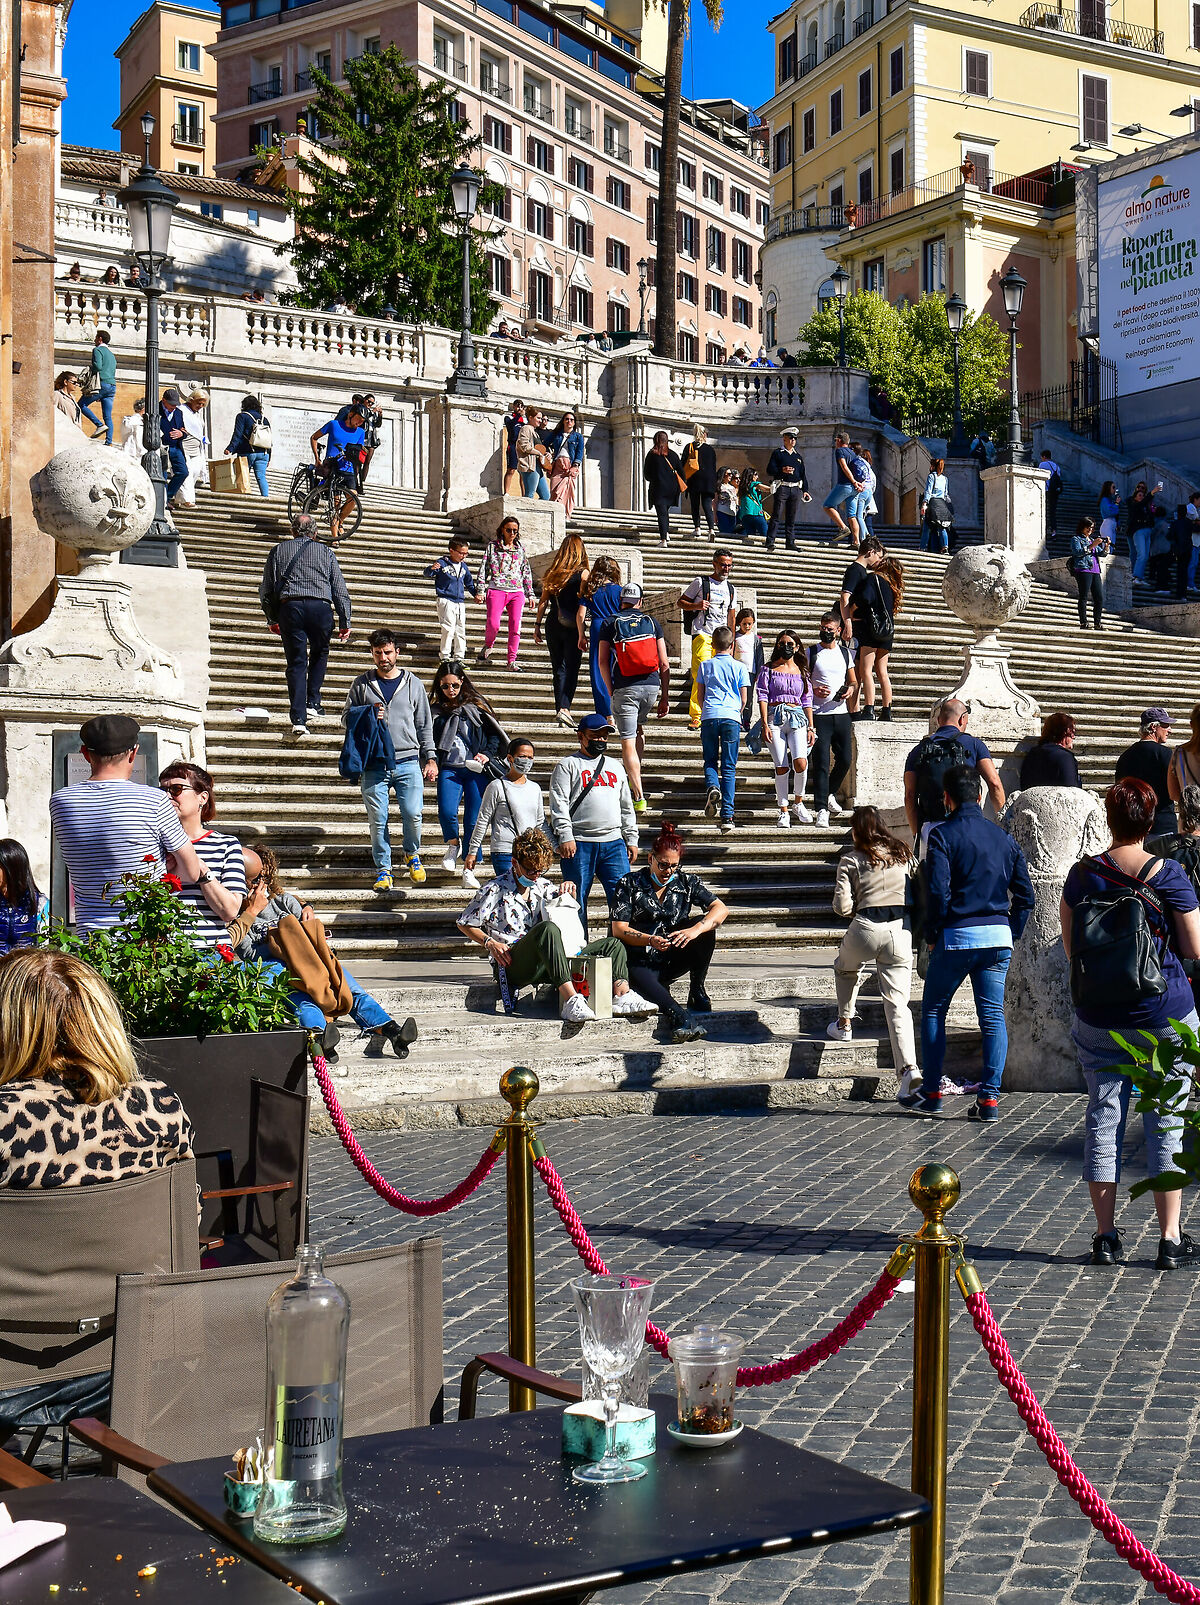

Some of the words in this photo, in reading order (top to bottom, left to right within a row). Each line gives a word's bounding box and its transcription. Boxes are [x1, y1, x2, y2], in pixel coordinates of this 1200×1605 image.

[1125, 200, 1152, 218] almo
[1155, 187, 1190, 209] nature
[1125, 217, 1144, 227] OWNED
[1154, 209, 1165, 217] THE
[1167, 201, 1191, 213] ANIMALS
[1122, 228, 1174, 256] Riporta
[1122, 256, 1132, 269] la
[1131, 238, 1199, 276] natura
[1120, 275, 1133, 290] nel
[1133, 261, 1194, 296] pianeta
[1113, 320, 1123, 329] dei
[1123, 315, 1140, 327] ricavi
[1140, 310, 1159, 323] (dopo
[1159, 306, 1175, 316] costi
[1180, 297, 1200, 311] tasse)
[1121, 305, 1132, 318] pet
[1132, 303, 1146, 313] food
[1146, 300, 1158, 309] che
[1159, 294, 1182, 305] destina
[1120, 324, 1146, 338] ripristino
[1146, 319, 1162, 331] della
[1138, 337, 1146, 345] La
[1146, 328, 1181, 344] chiamiamo
[1125, 343, 1165, 360] Reintegration
[1165, 336, 1196, 349] Economy.
[581, 770, 617, 788] GAP
[1142, 888, 1161, 906] Canon
[276, 1417, 335, 1448] LAURETANA
